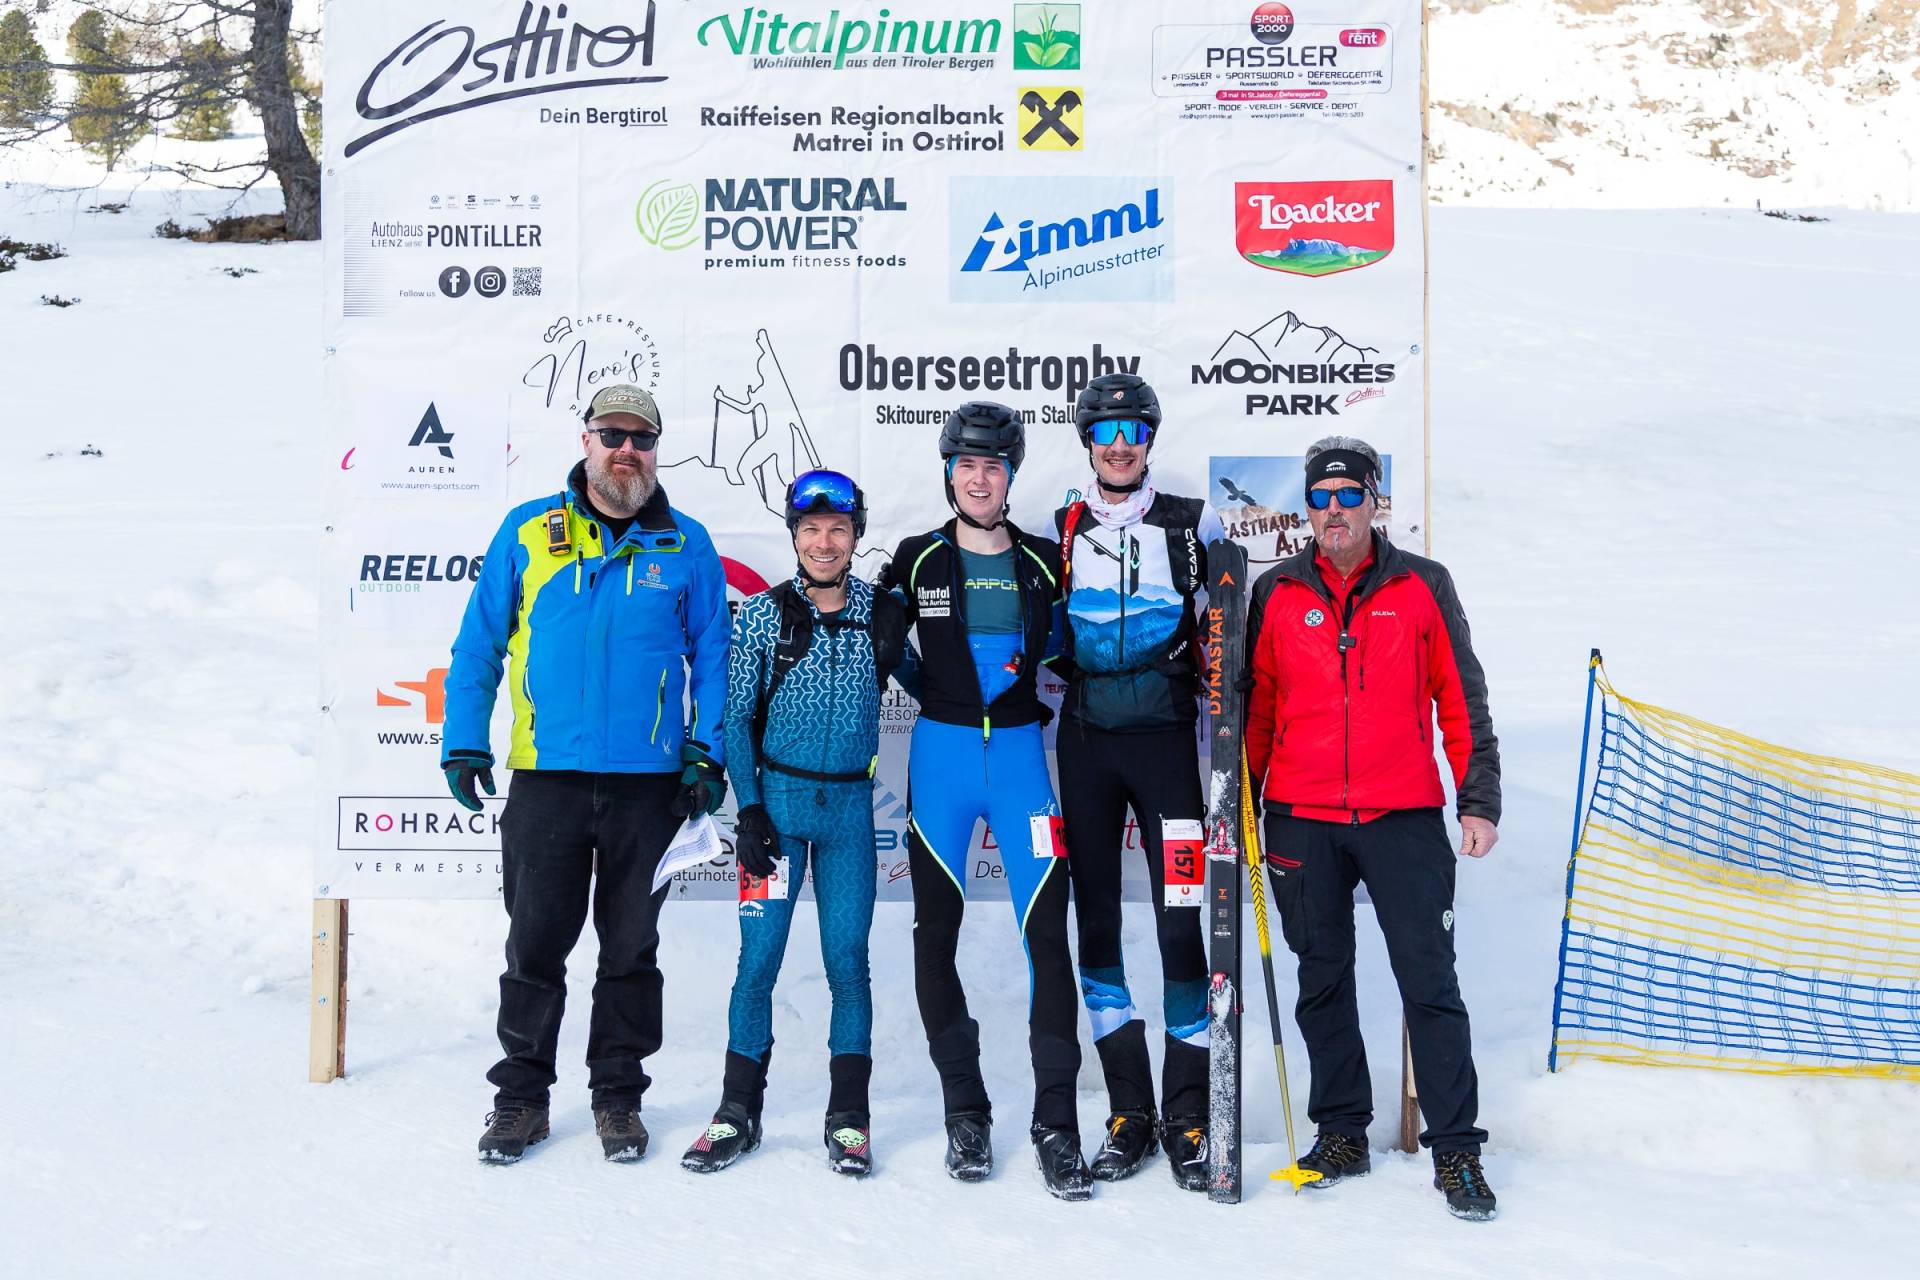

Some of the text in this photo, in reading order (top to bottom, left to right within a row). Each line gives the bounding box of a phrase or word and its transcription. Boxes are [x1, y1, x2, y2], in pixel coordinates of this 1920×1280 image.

[1254, 14, 1290, 24] SPORT
[1257, 24, 1287, 33] 2000
[697, 6, 1001, 70] Vitalpinum
[1348, 31, 1377, 45] rent
[355, 0, 657, 121] Osttirol
[752, 56, 994, 71] Wohlfühlen aus den Tiroler Bergen
[1206, 45, 1337, 68] PASSLER
[1171, 70, 1383, 81] PASSLER SPORTSWORLD DEFEREGGENTAL
[540, 107, 668, 127] Dein Bergtirol
[701, 104, 1004, 130] Raiffeisen Regionalbank
[1184, 103, 1211, 111] SPORT
[1289, 102, 1323, 110] SERVICE
[1331, 102, 1358, 110] DEPOT
[793, 131, 1004, 152] Matrei in Osttirol
[705, 177, 907, 212] NATURAL
[1248, 194, 1381, 231] Loacker
[371, 221, 423, 237] Autohaus
[960, 187, 1164, 272] Zimml
[371, 239, 403, 248] LIENZ
[704, 254, 907, 270] premium fitness foods
[1022, 242, 1165, 291] Alpinausstatter
[400, 290, 424, 298] Follow
[576, 313, 613, 327] CAFE
[522, 339, 646, 408] Nero's
[1191, 358, 1396, 385] MOONBIKES
[1246, 394, 1340, 416] PARK
[408, 466, 456, 474] AUREN
[380, 481, 480, 491] www.auren-sports.com
[1184, 528, 1198, 576] CAMP
[359, 583, 421, 593] OUTDOOR
[1168, 640, 1188, 661] CAMP
[1208, 606, 1224, 715] DYNASTAR
[1173, 845, 1195, 879] 157
